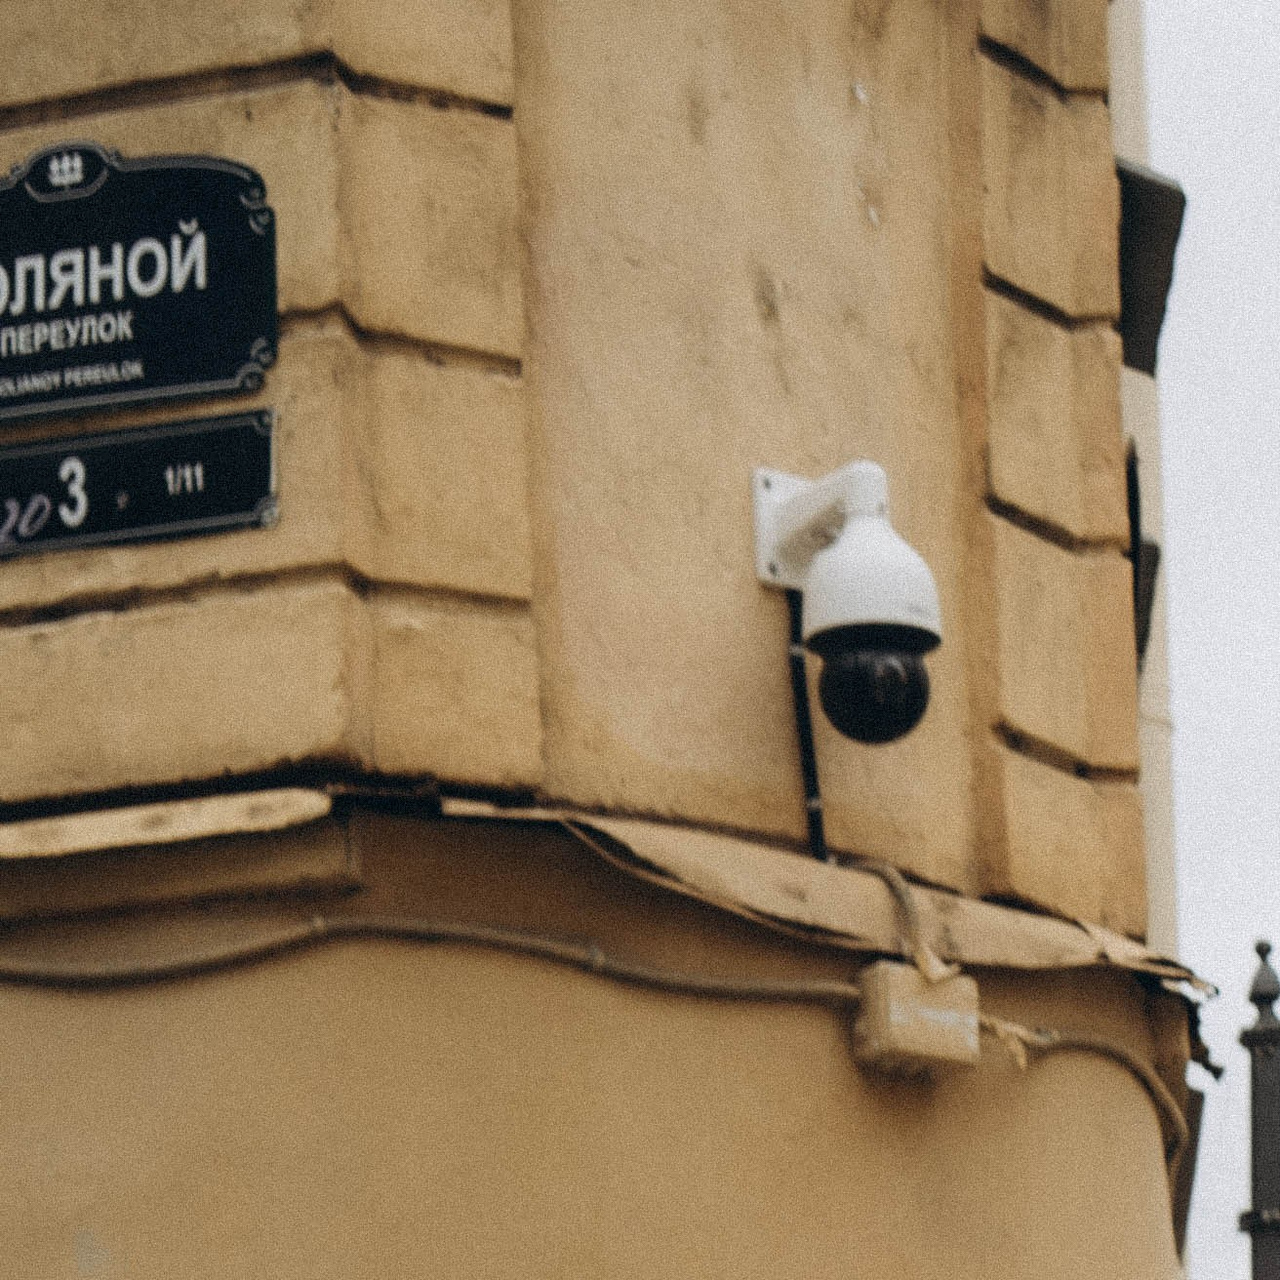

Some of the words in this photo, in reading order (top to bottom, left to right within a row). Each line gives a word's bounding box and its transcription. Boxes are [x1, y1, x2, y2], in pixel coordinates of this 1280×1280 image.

[0, 217, 207, 316] ЛЯНОЙ
[0, 309, 134, 357] ПЕРЕУЛОК
[58, 455, 89, 528] 3
